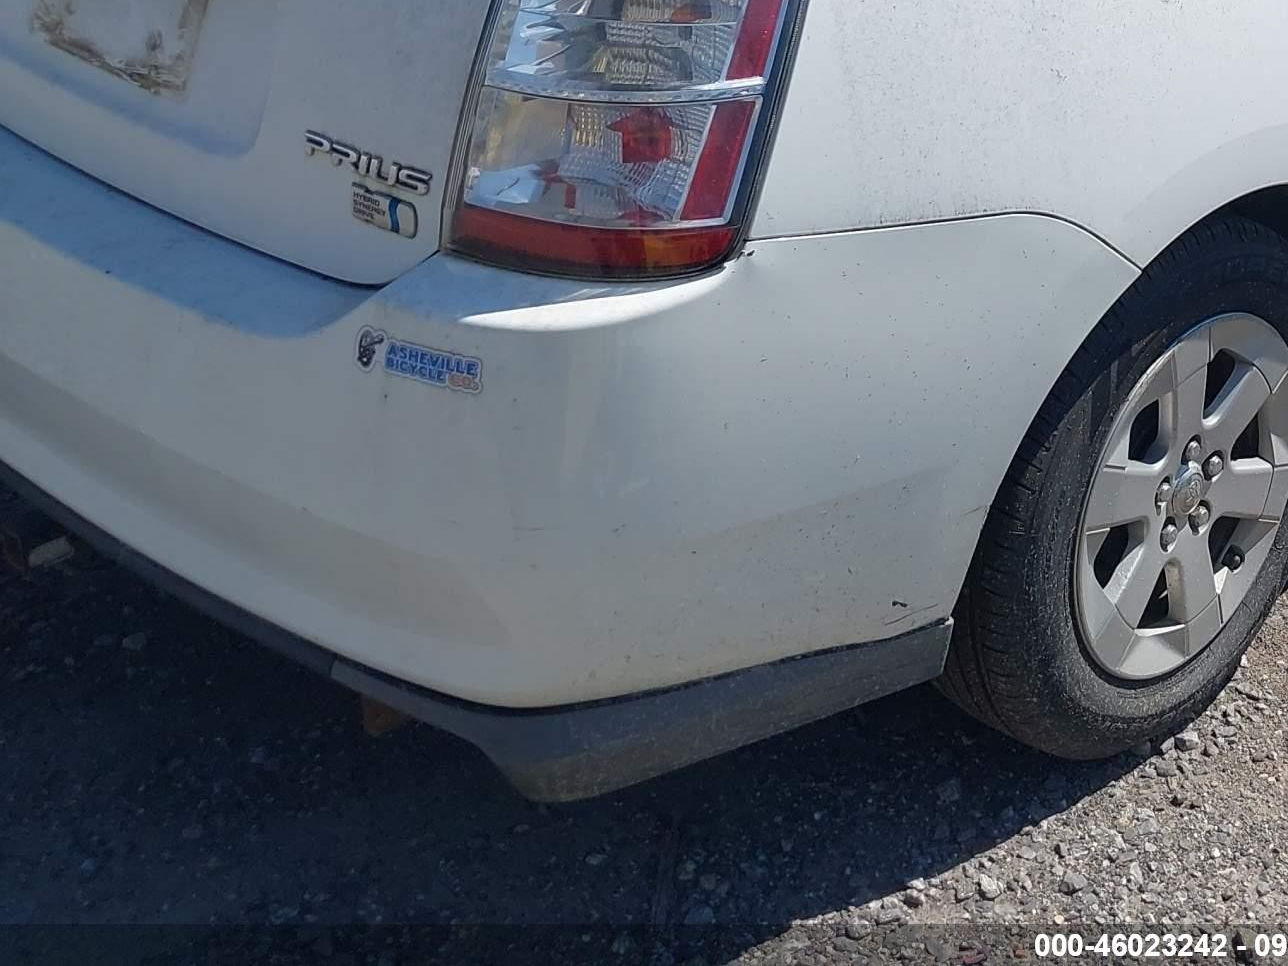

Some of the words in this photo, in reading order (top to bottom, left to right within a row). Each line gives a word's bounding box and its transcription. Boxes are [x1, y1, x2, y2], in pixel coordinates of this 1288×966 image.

[304, 129, 433, 197] PRIUS
[352, 191, 381, 208] HYBRID
[385, 357, 447, 383] BICYCLE
[387, 344, 480, 377] ASHEVILLE
